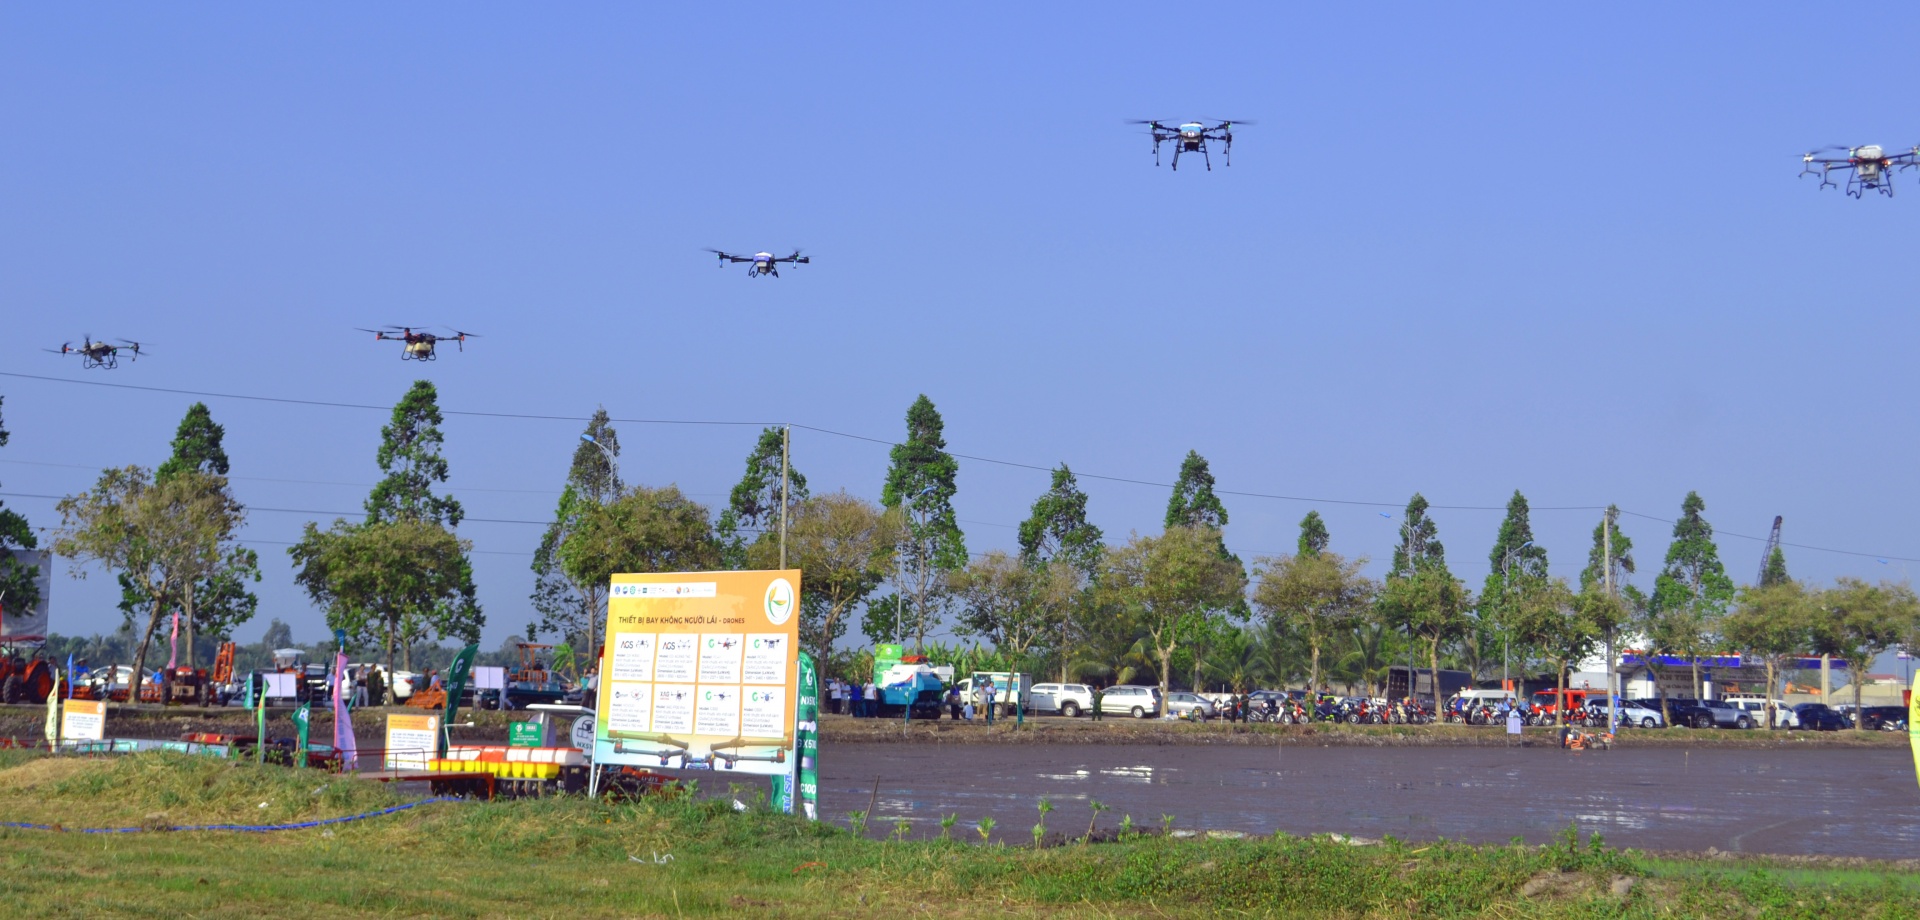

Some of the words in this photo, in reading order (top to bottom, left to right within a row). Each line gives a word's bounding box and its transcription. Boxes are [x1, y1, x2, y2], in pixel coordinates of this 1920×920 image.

[618, 614, 636, 624] THIẾT
[638, 616, 645, 625] BỊ
[646, 616, 659, 624] BAY
[660, 615, 682, 624] KHÔNG
[684, 614, 705, 624] NGƯỜI
[706, 614, 718, 624] LÁI
